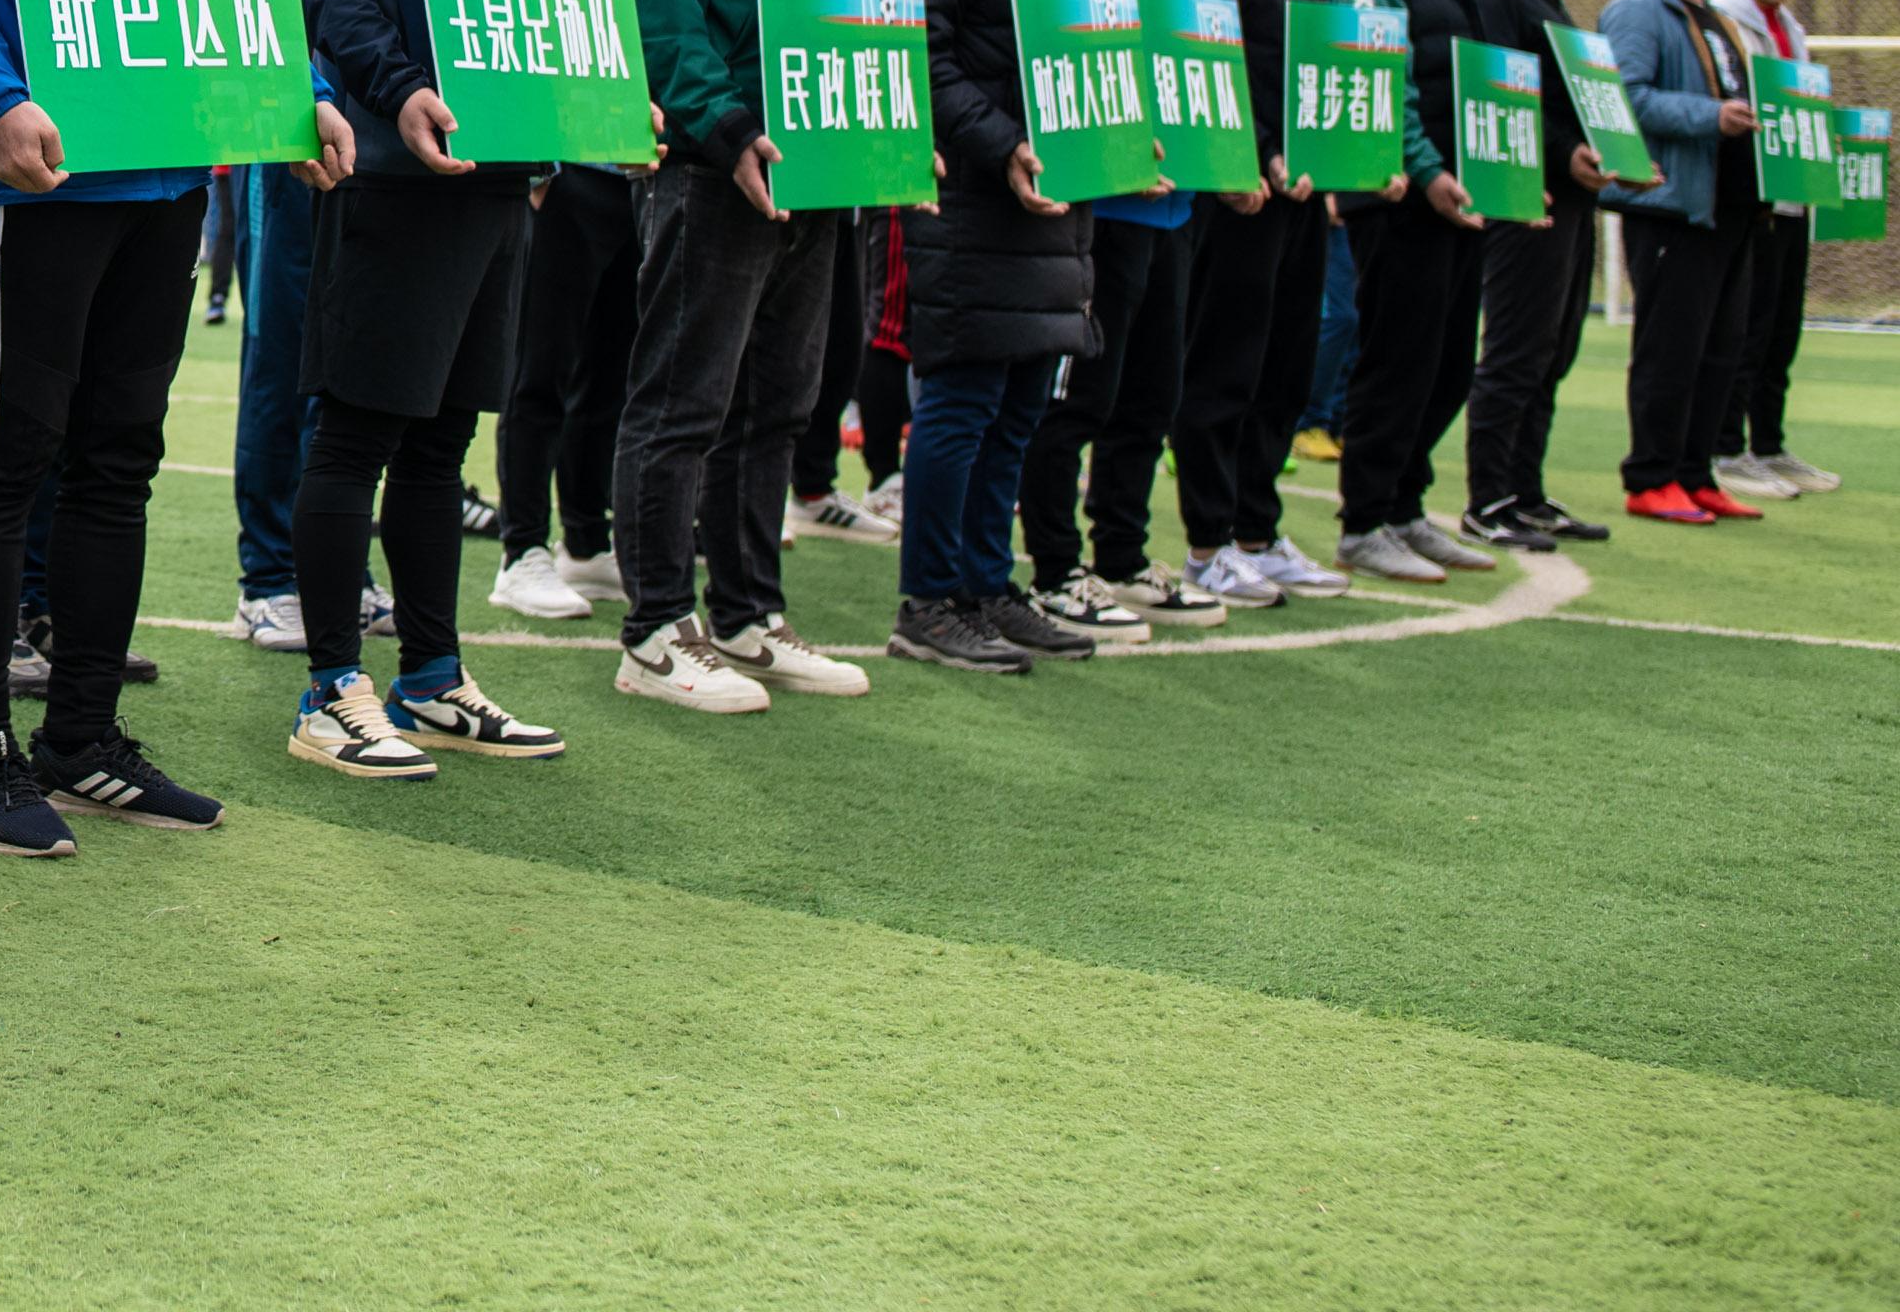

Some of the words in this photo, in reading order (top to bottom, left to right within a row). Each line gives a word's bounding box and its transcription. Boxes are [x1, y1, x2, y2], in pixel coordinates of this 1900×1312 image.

[779, 46, 918, 131] 民政联队
[1031, 48, 1144, 135] 财政人社队
[1297, 63, 1395, 133] 漫步者队
